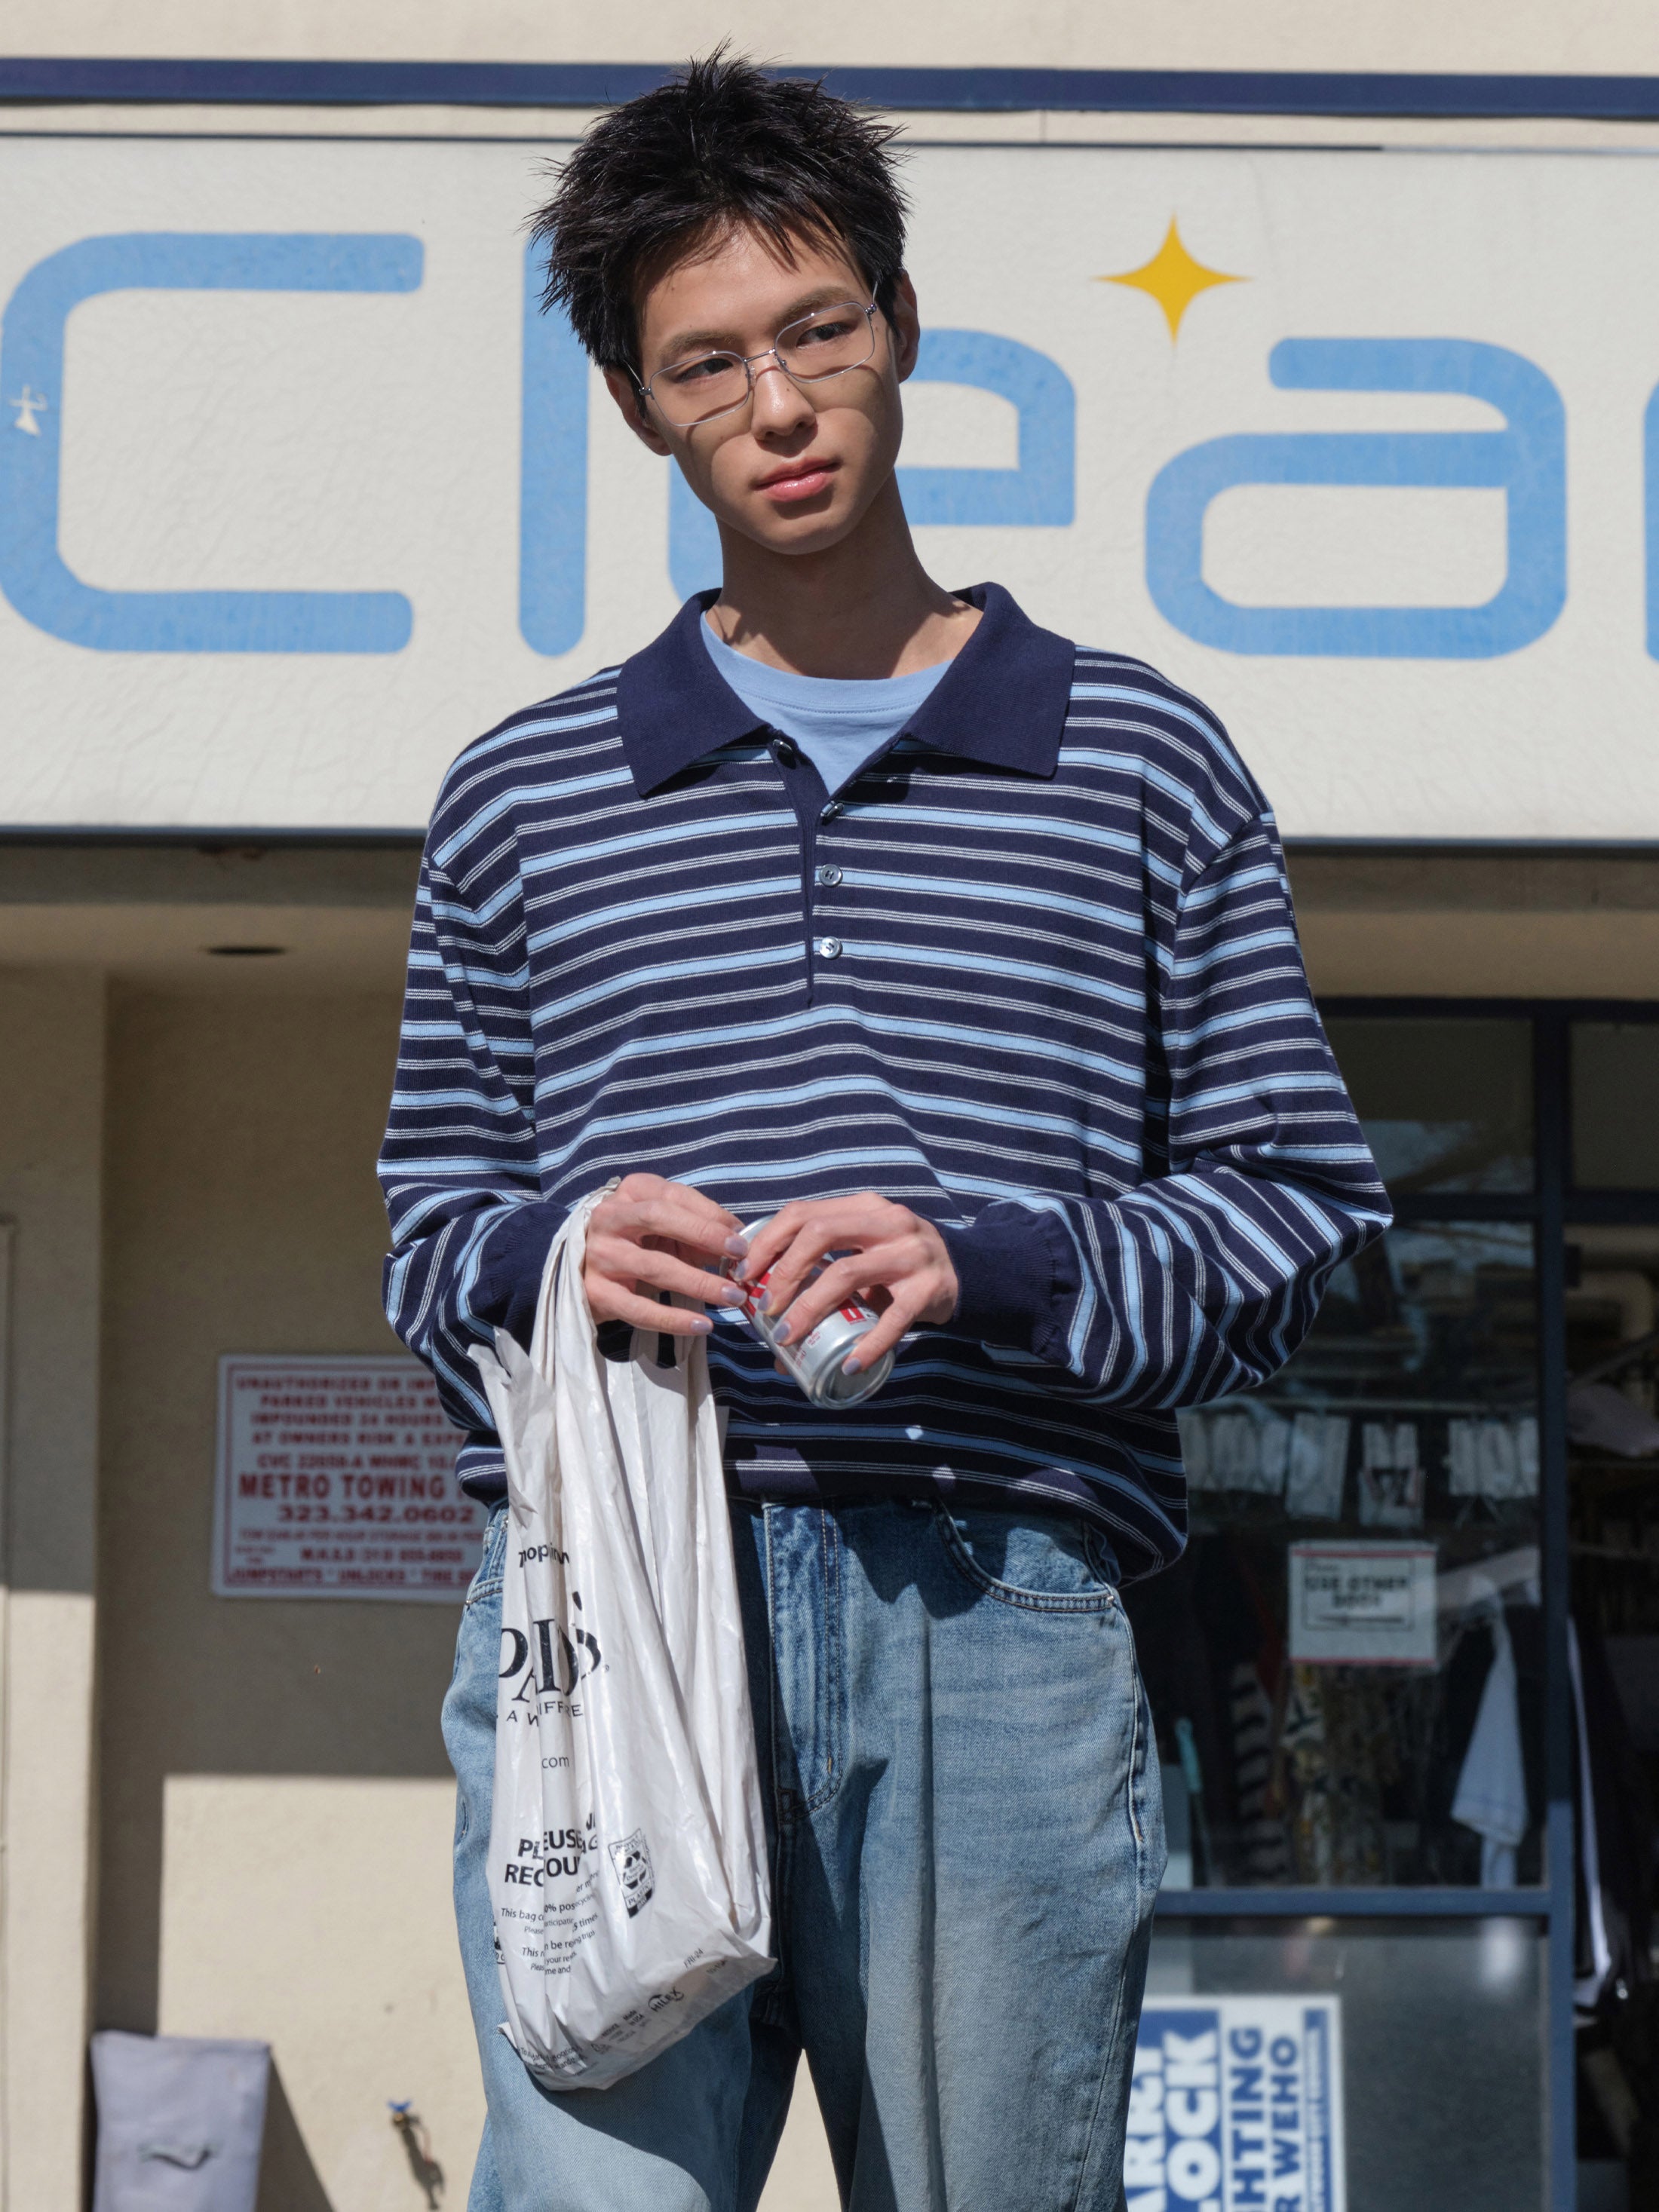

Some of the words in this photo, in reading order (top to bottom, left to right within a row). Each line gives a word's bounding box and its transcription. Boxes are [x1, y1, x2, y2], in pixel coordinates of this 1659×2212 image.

[1, 231, 1659, 657] Clea
[240, 1475, 330, 1498] METRO
[342, 1475, 445, 1499] TOWING
[278, 1505, 475, 1524] 323.342.0602
[501, 1907, 517, 1919] This
[519, 1910, 536, 1922] bag
[650, 1987, 681, 2013] HILEX
[1271, 2037, 1300, 2178] WEHO
